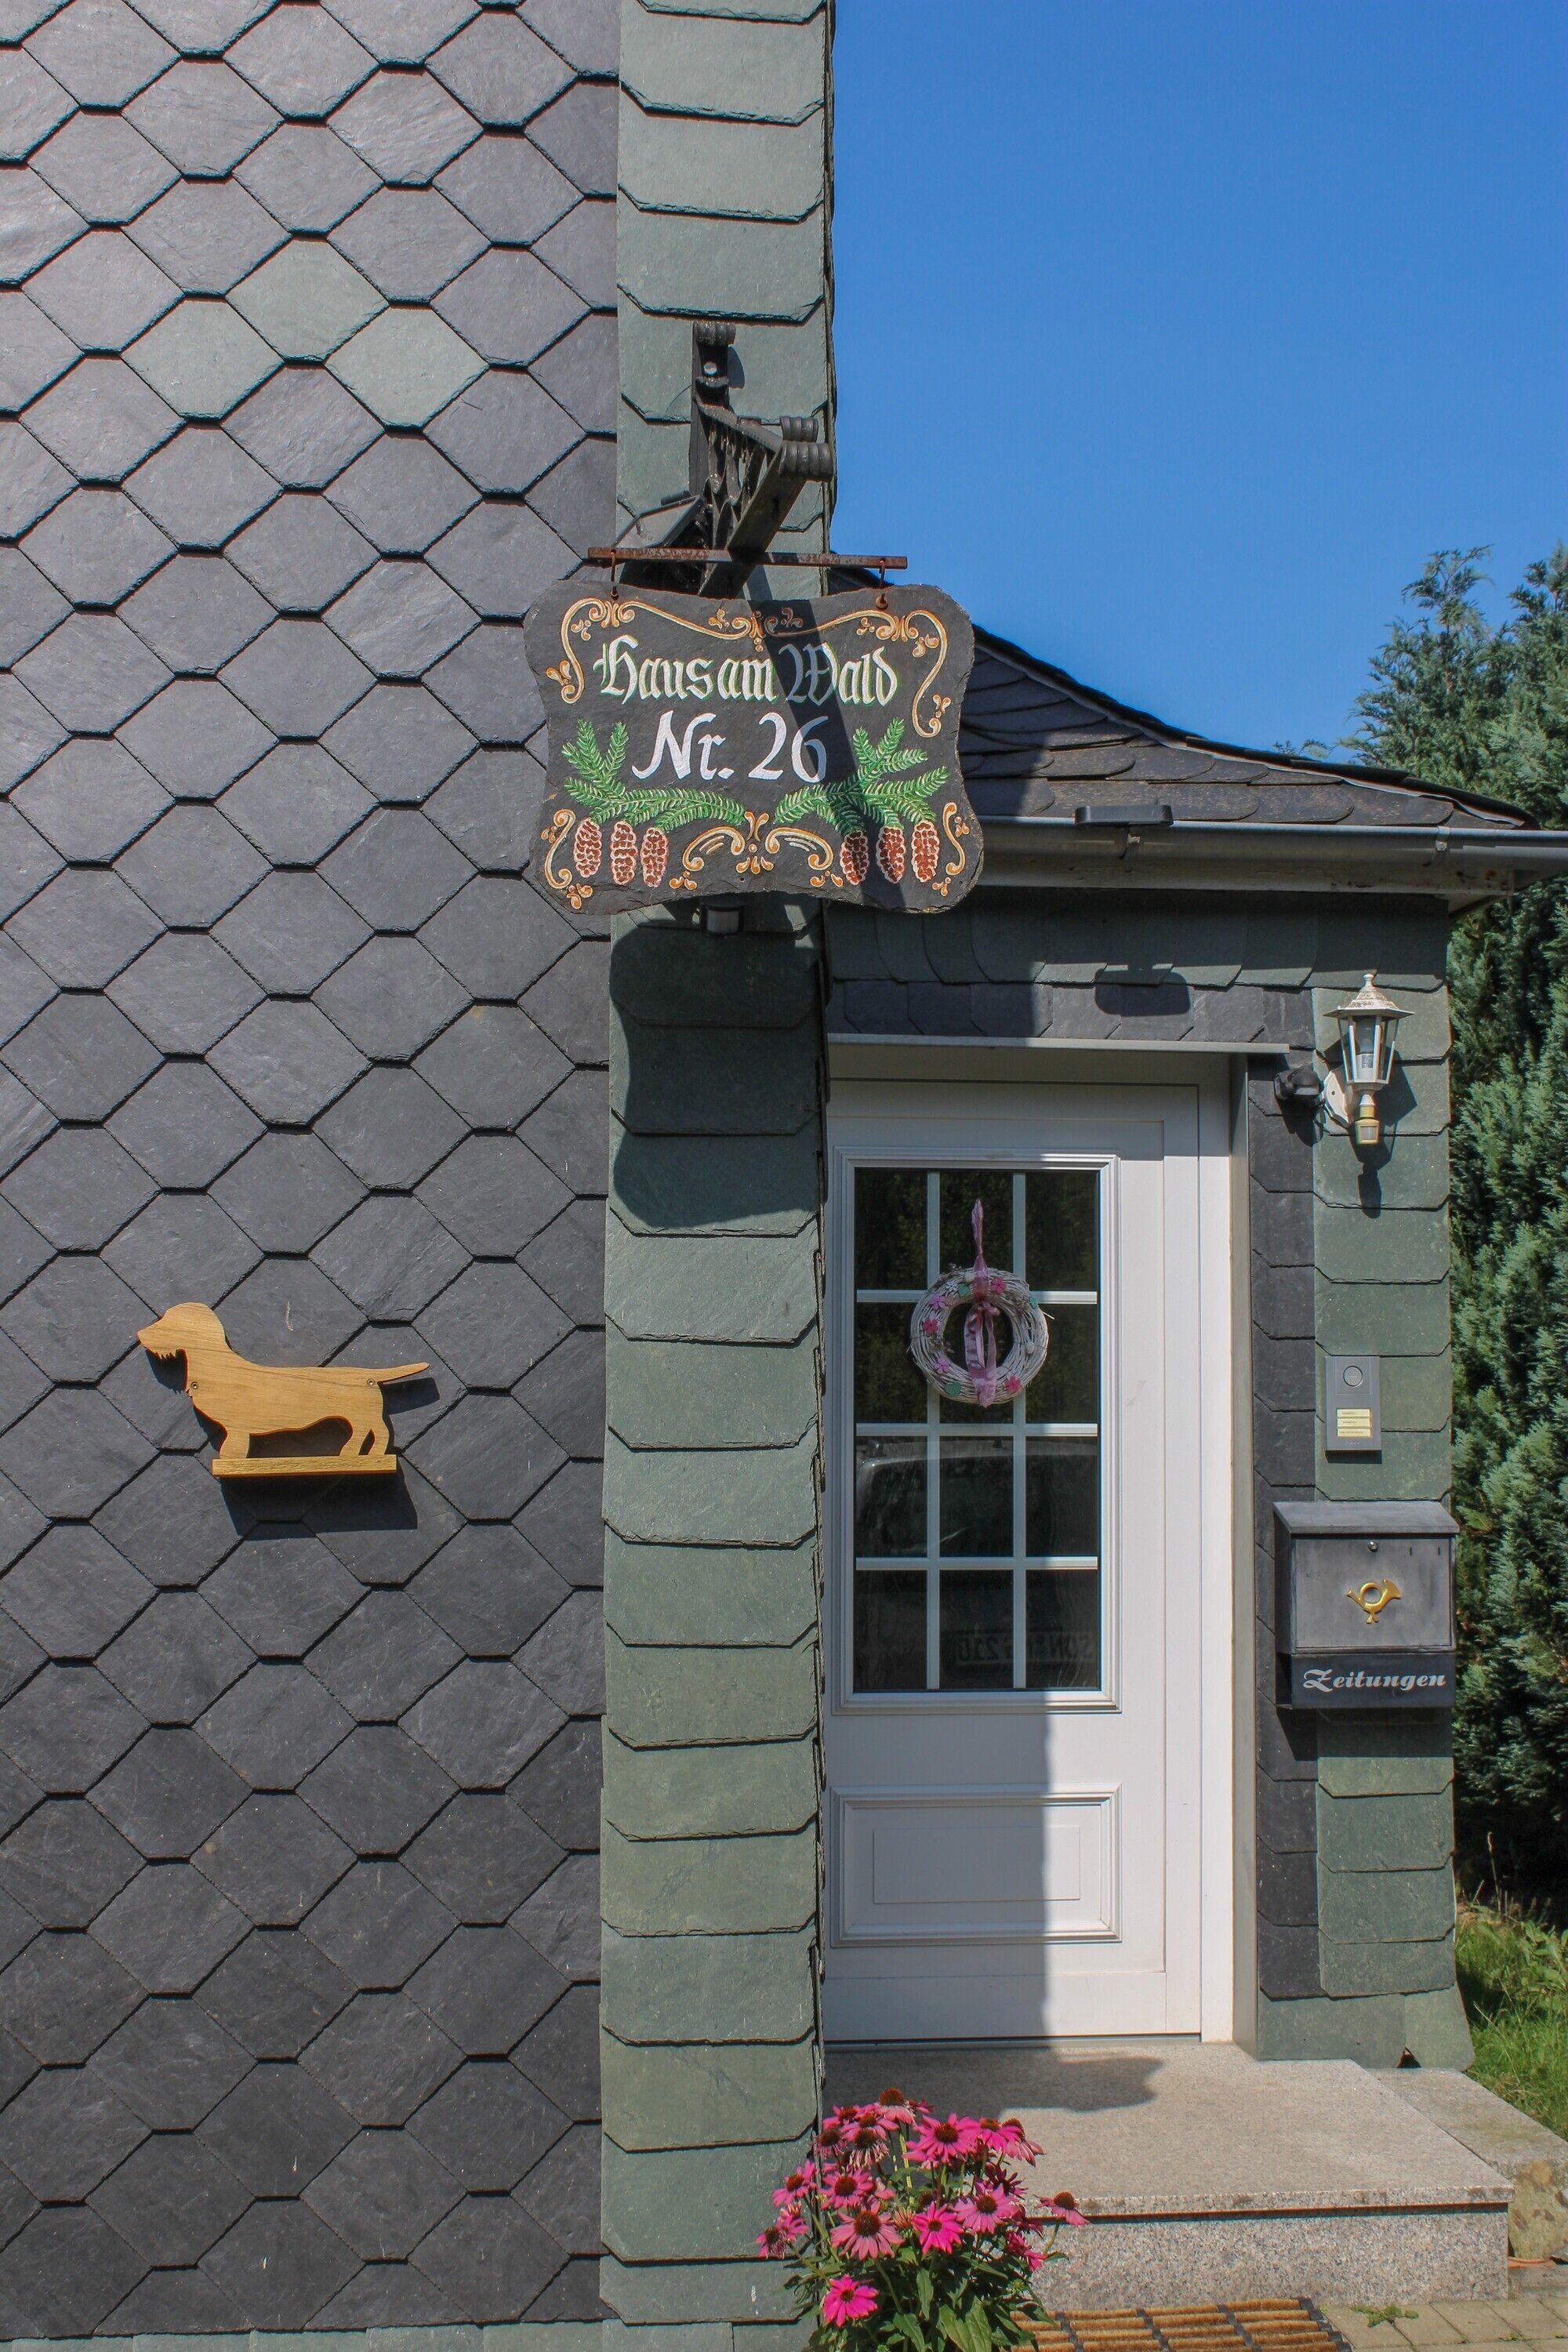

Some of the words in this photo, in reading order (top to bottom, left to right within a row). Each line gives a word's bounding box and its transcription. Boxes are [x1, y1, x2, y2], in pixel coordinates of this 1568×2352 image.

[592, 633, 715, 705] Haus
[717, 656, 779, 704] am
[778, 641, 902, 706] Wald
[631, 710, 735, 780] Nr.
[748, 712, 829, 783] 26
[1302, 1668, 1447, 1693] Zeitungen
